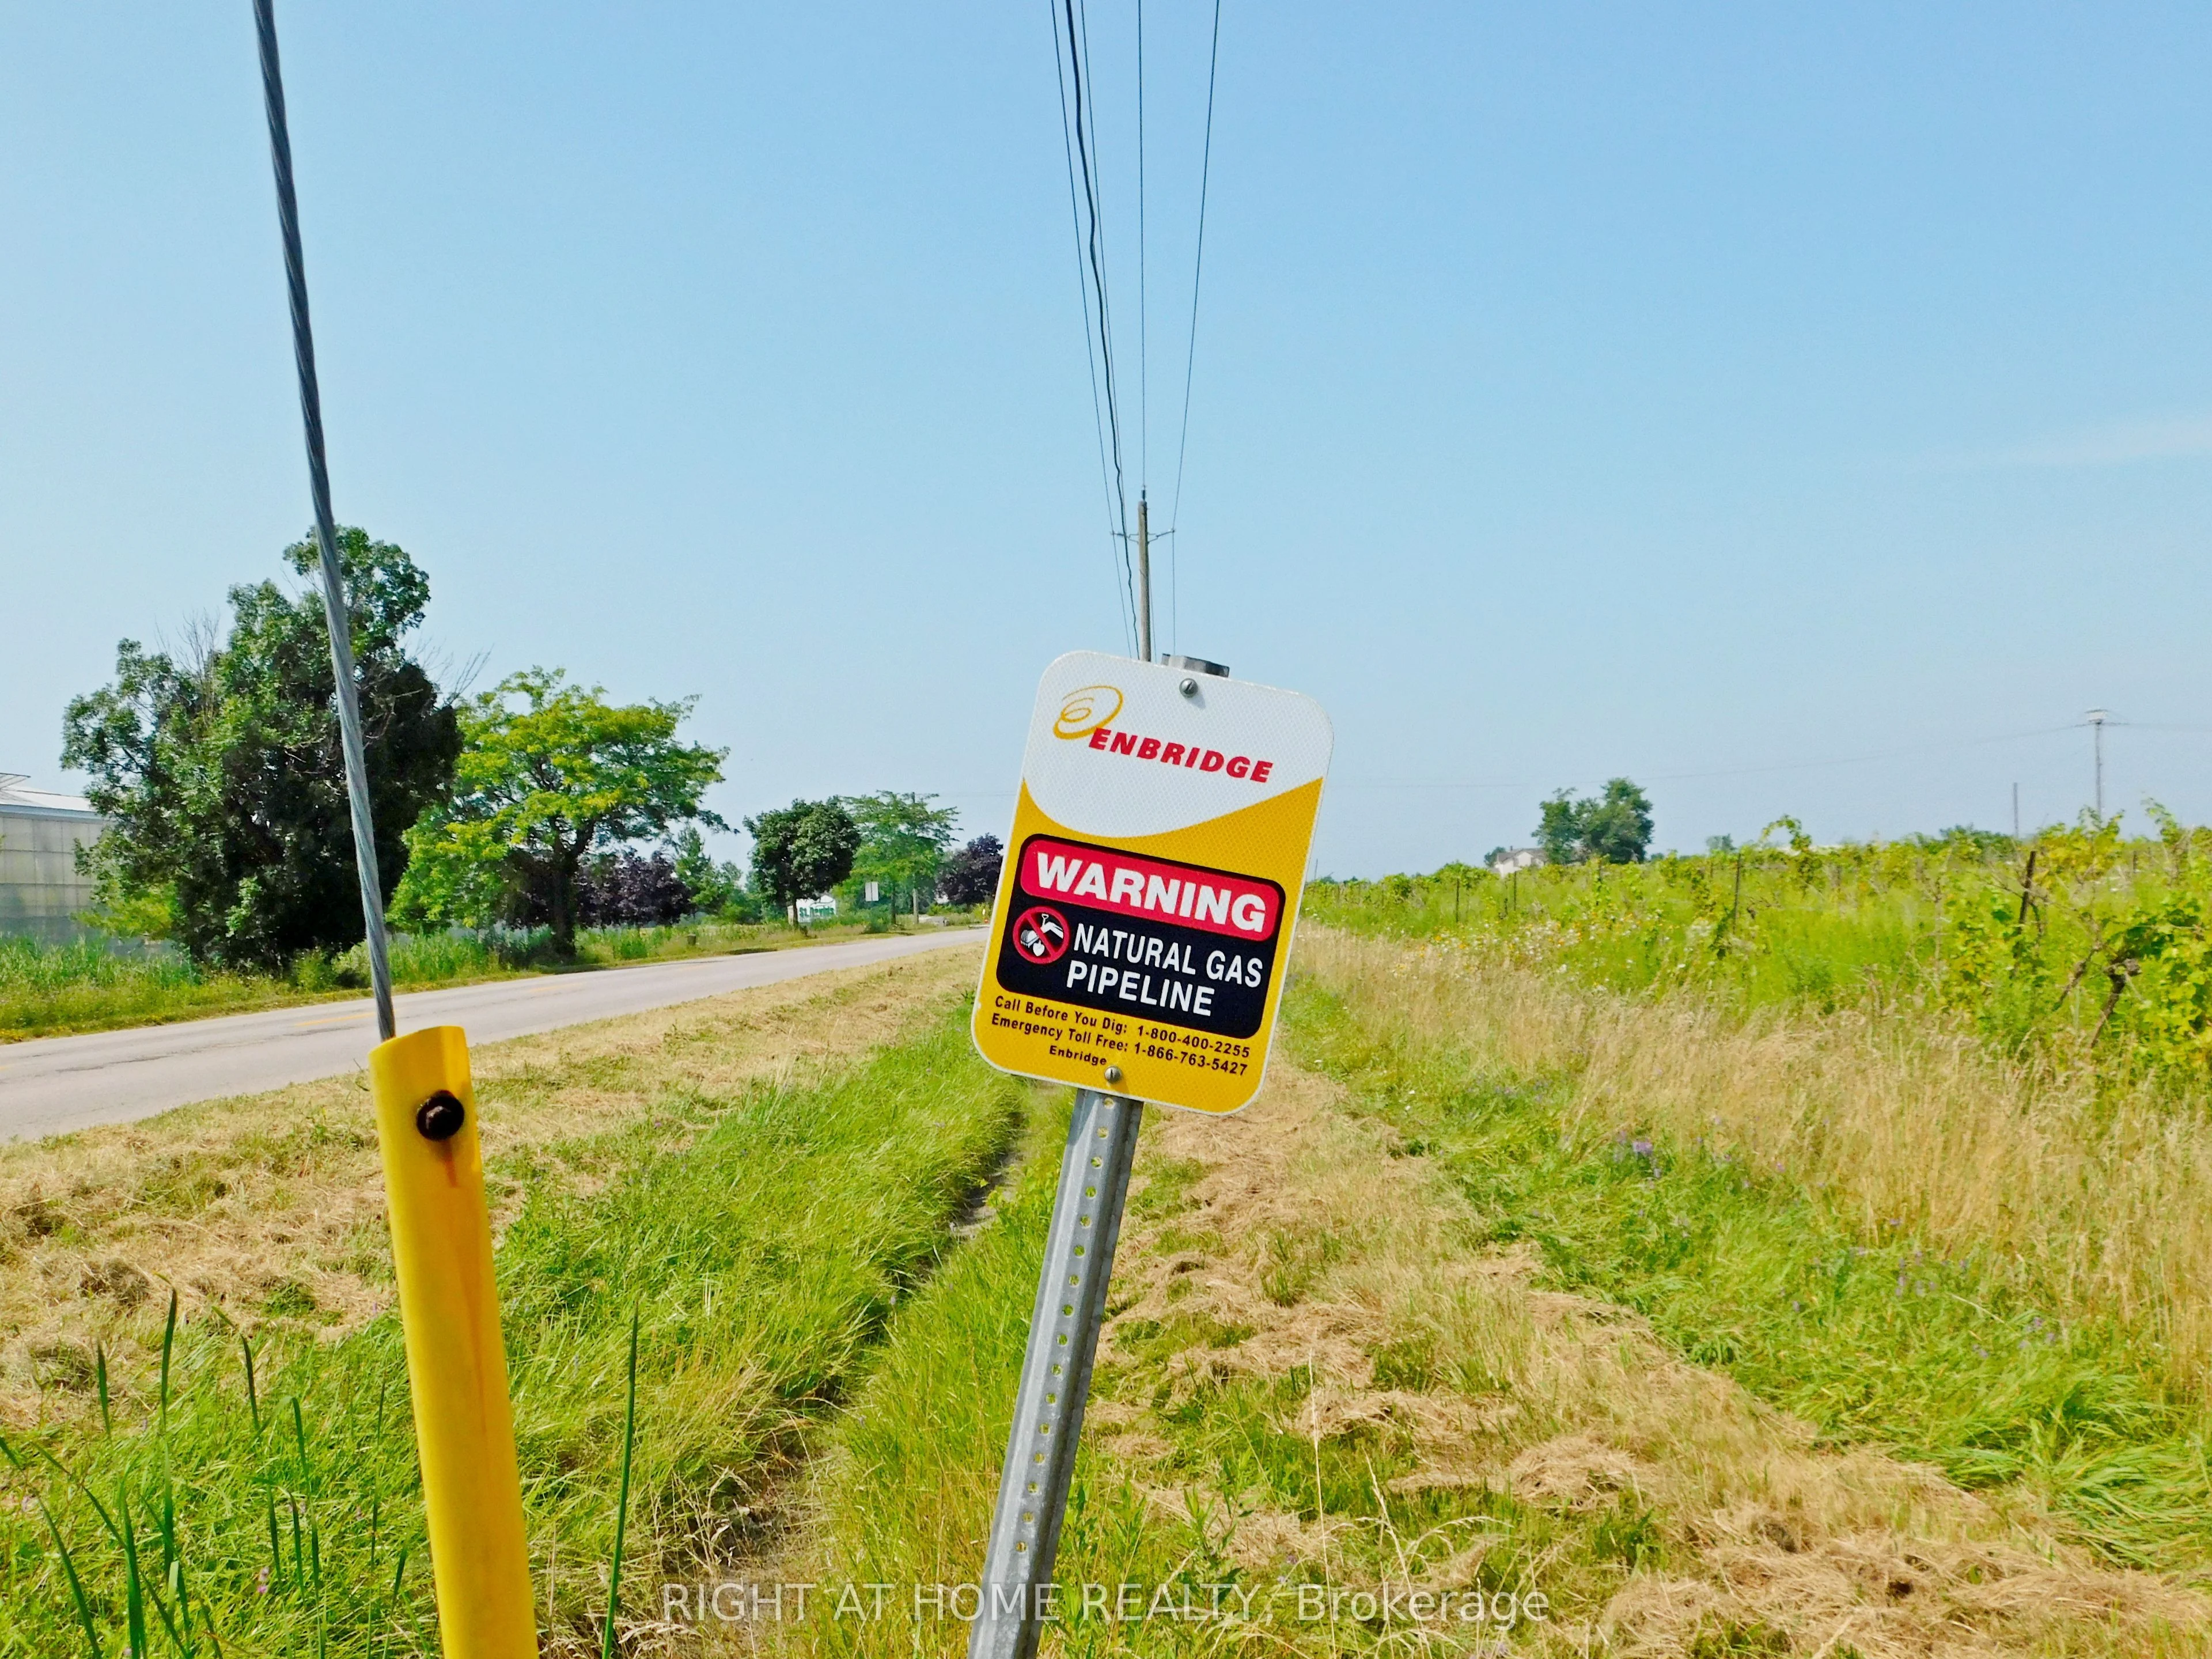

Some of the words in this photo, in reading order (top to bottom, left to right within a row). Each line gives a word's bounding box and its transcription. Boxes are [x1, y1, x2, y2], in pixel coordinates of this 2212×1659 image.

[1088, 727, 1274, 783] ENBRIDGE
[1037, 852, 1267, 933] WARNING
[1073, 922, 1196, 975] NATURAL
[1206, 950, 1263, 988] GAS
[1066, 960, 1215, 1017] PIPELINE
[991, 1012, 1063, 1041] Emergency
[1069, 1028, 1092, 1044] Toll
[1096, 1033, 1128, 1052] Free:
[1134, 1041, 1248, 1076] 1-866-763-5427
[995, 995, 1021, 1012] Call
[1025, 1001, 1068, 1021] Before
[1074, 1011, 1097, 1027] You
[1102, 1017, 1127, 1035] Dig:
[1138, 1025, 1251, 1058] 1-800-400-2255
[1049, 1044, 1107, 1066] Enbridge
